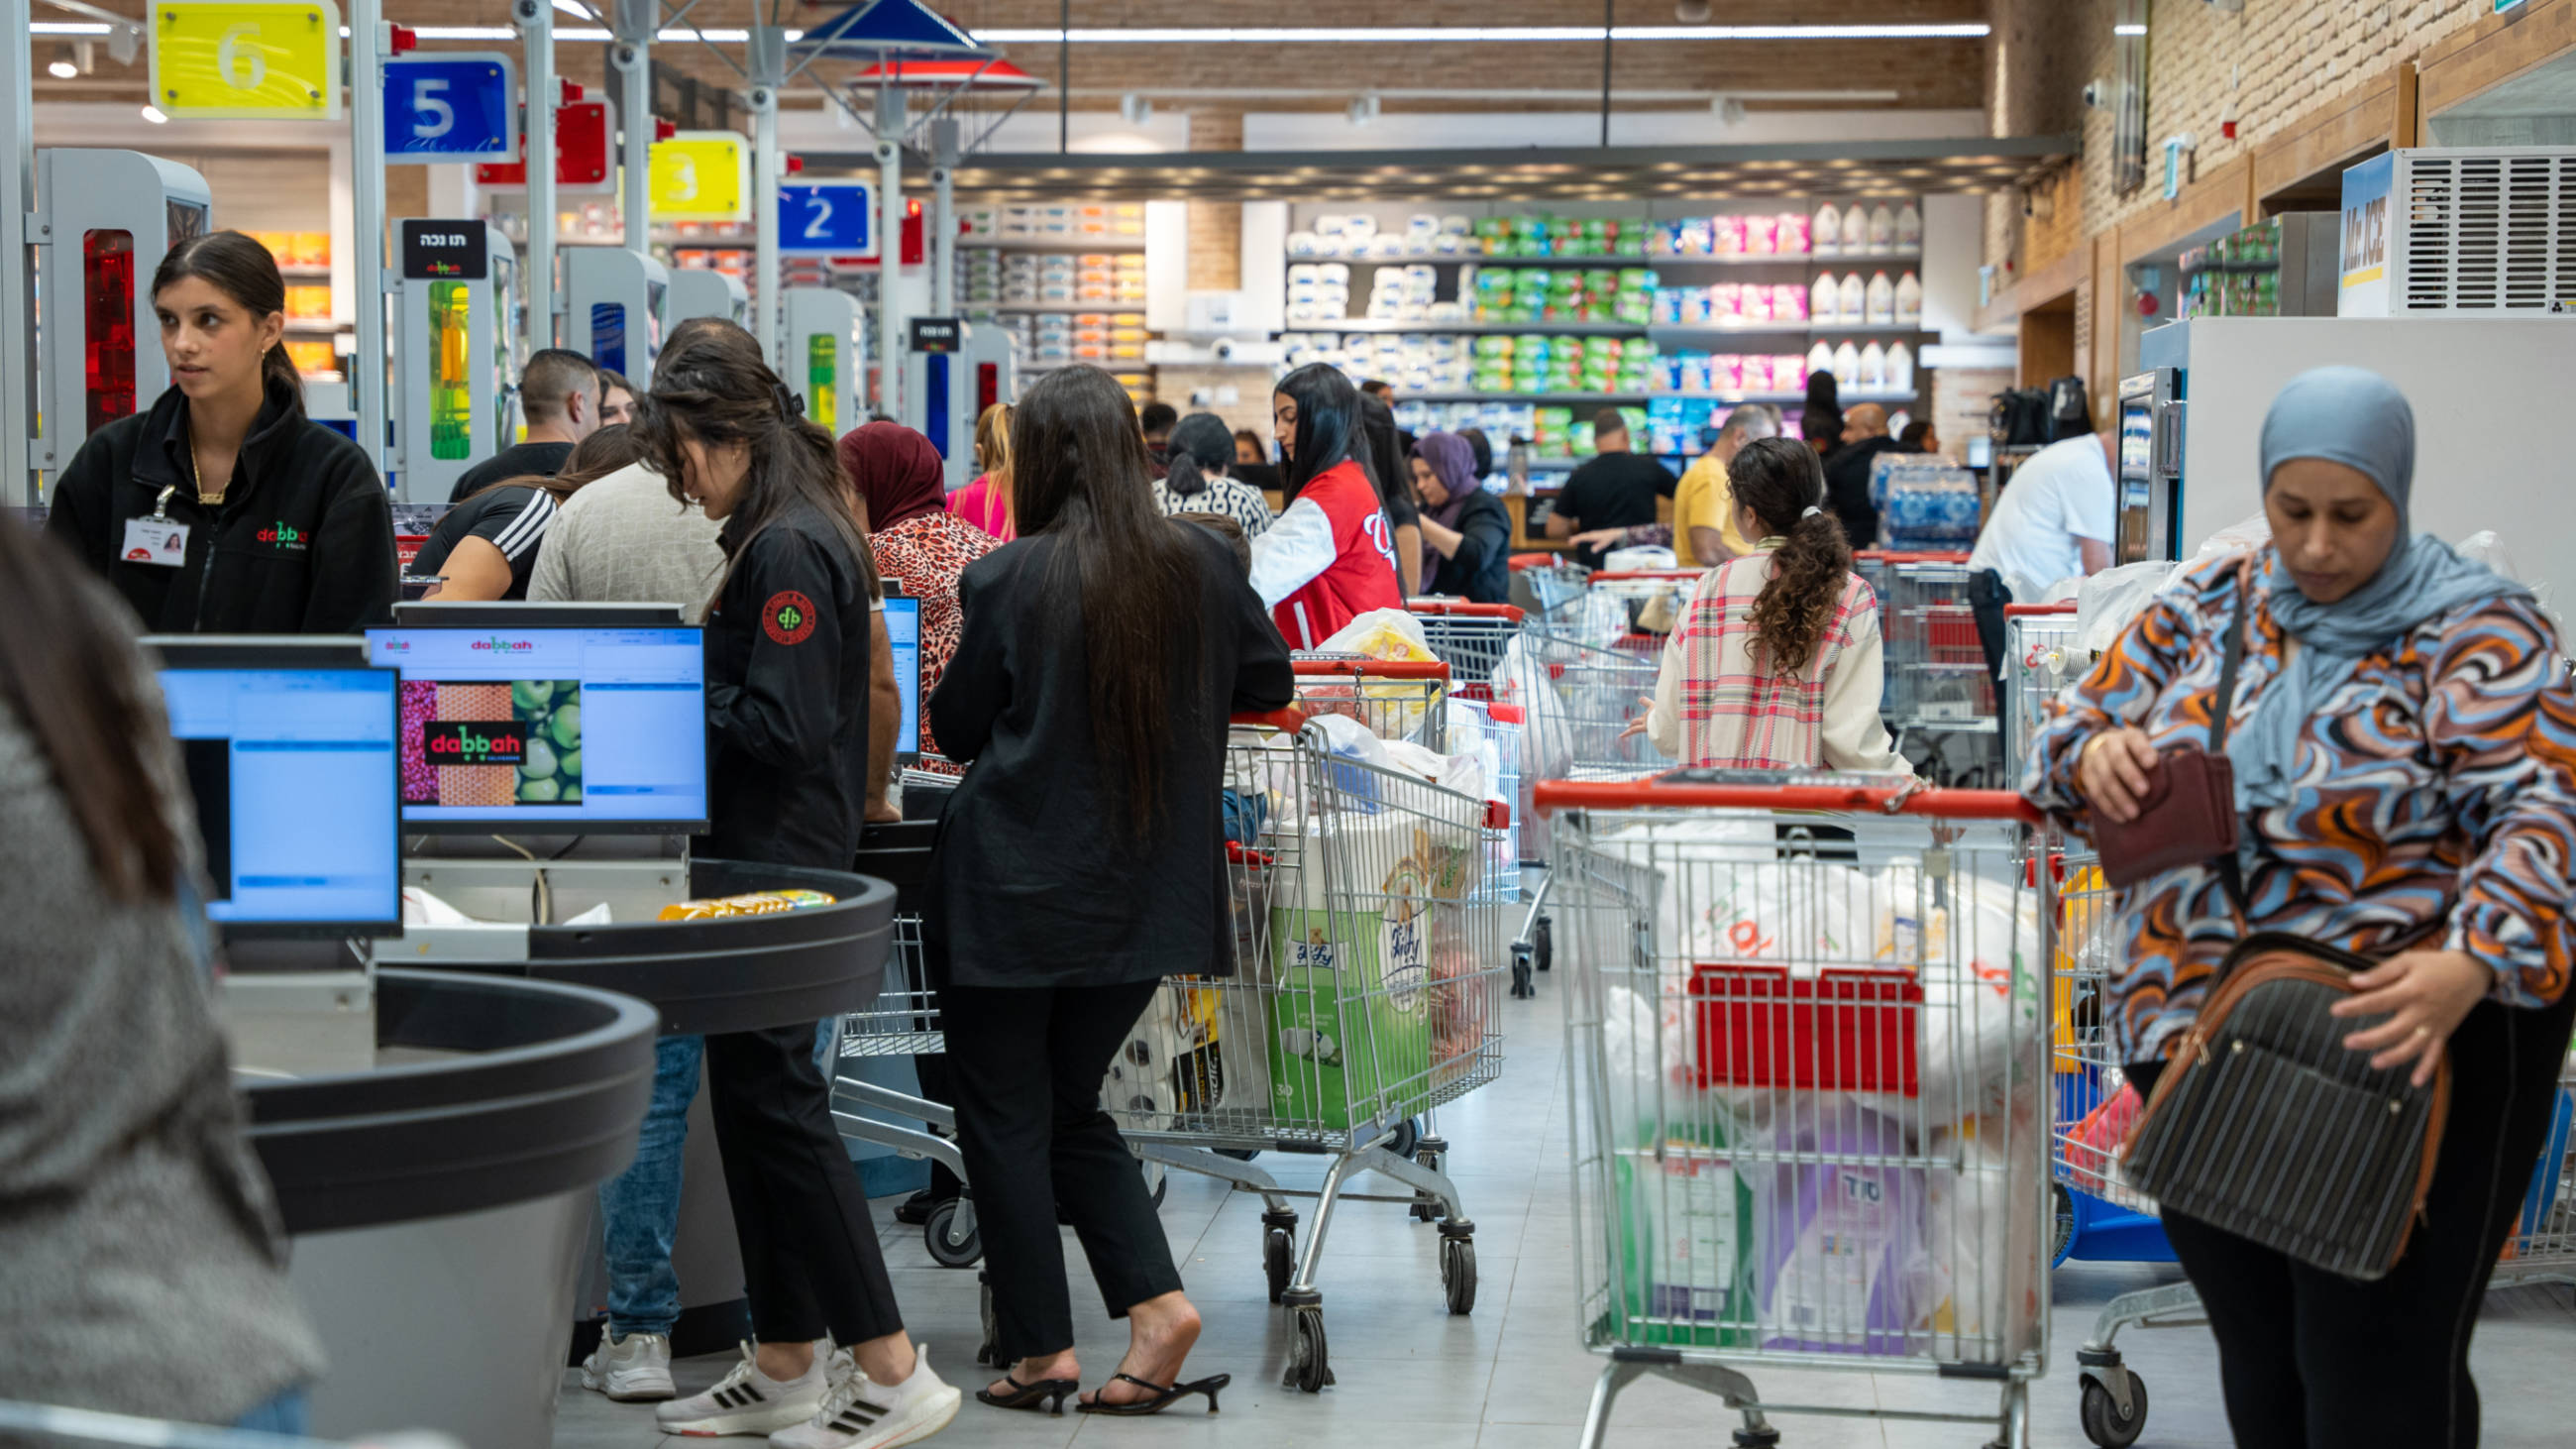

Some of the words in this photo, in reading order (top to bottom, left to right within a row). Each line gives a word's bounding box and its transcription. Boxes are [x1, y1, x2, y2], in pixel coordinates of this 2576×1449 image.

[218, 22, 266, 90] 6
[413, 79, 454, 138] 5
[667, 152, 698, 201] 3
[804, 198, 833, 238] 2
[2363, 196, 2387, 267] ICE
[420, 234, 446, 247] נכה
[449, 234, 467, 247] תו
[257, 521, 308, 542] dabba
[471, 636, 533, 651] dabbah
[431, 725, 520, 754] dabbah
[1276, 1083, 1293, 1096] 30
